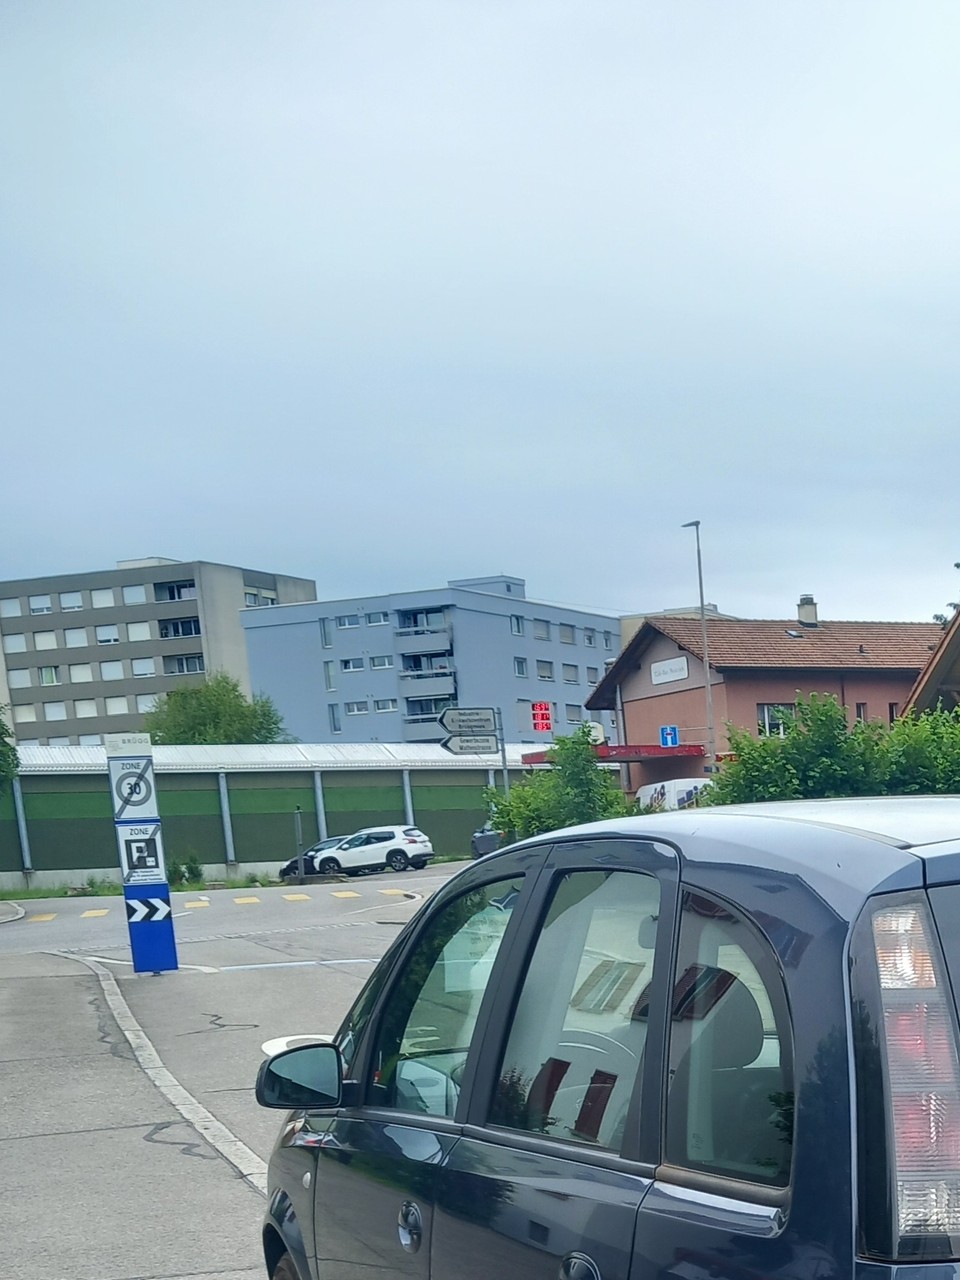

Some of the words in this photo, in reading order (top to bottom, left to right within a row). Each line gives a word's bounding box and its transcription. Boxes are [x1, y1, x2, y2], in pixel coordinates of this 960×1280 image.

[120, 762, 141, 770] ZONE
[126, 782, 141, 796] 30
[129, 827, 149, 836] ZONE
